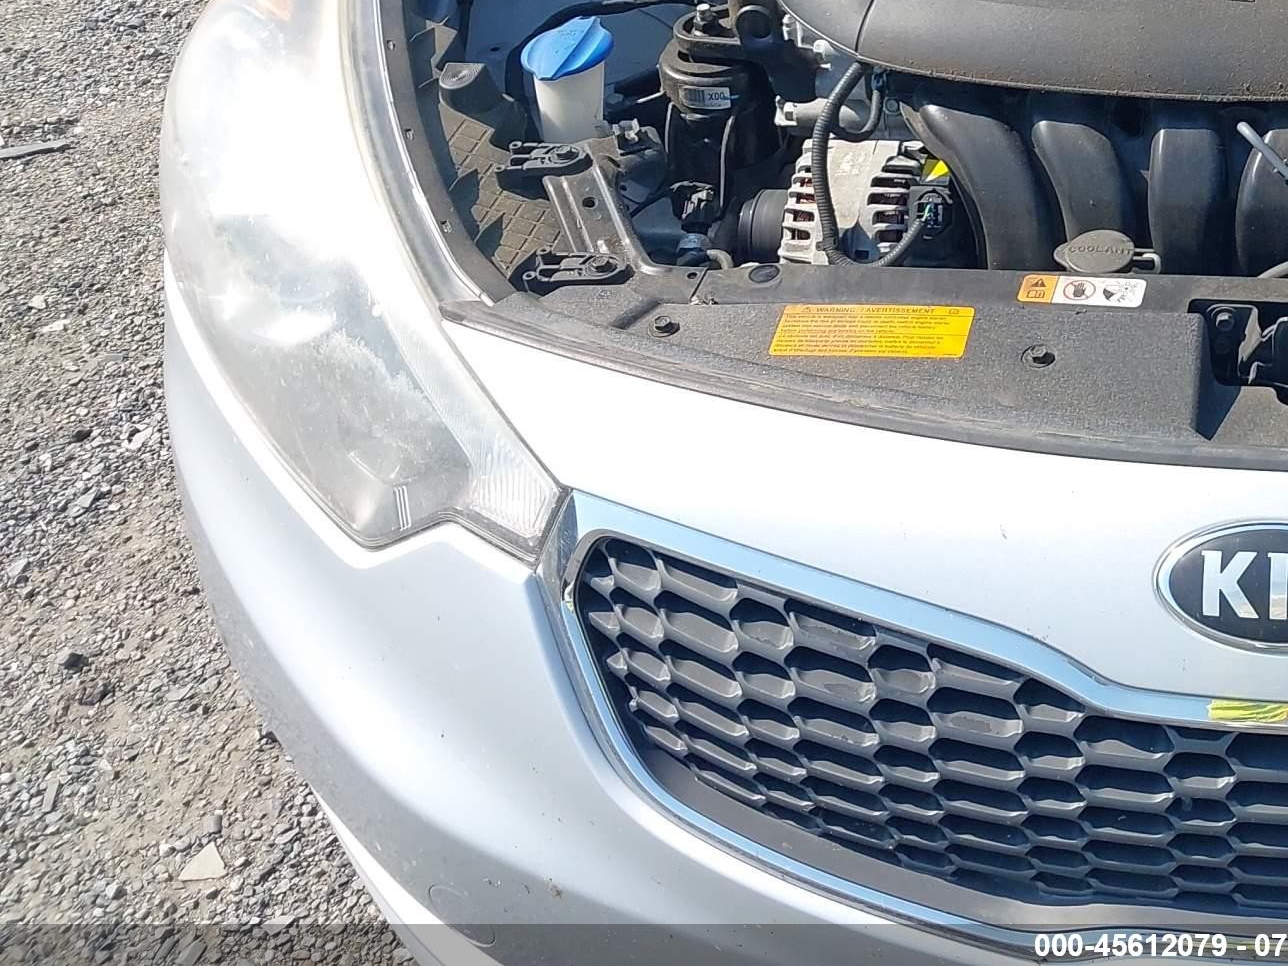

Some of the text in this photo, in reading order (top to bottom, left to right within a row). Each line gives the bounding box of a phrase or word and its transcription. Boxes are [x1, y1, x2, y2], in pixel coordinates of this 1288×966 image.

[1069, 245, 1134, 256] COOLANT
[816, 306, 856, 314] WARNING
[866, 306, 936, 315] AVERTISSEMENT
